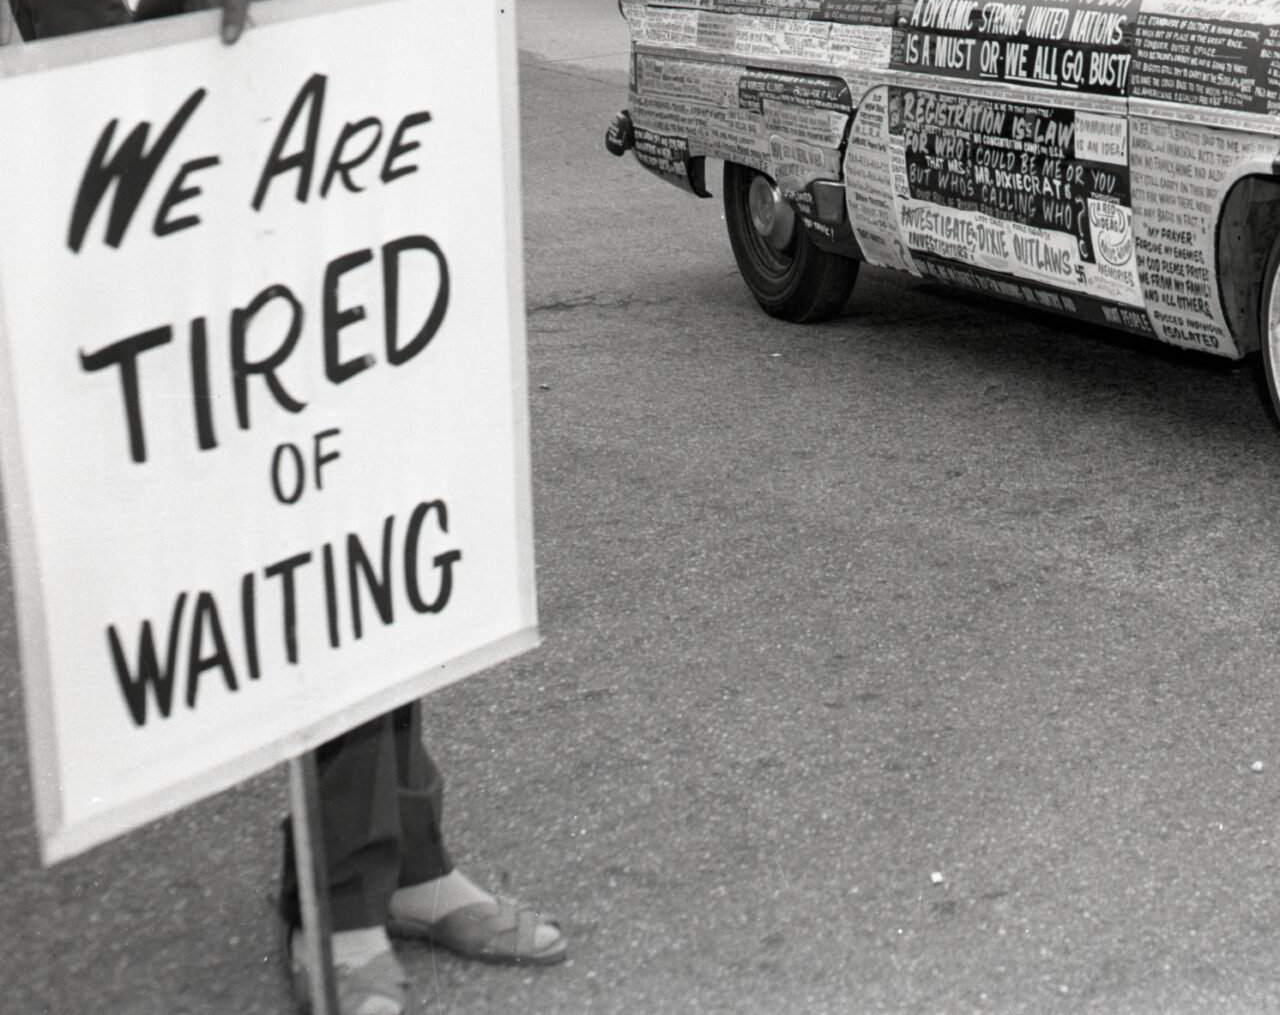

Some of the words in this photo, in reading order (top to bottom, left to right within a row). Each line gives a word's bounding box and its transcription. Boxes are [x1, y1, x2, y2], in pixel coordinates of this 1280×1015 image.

[979, 3, 1026, 36] STRONG
[1026, 6, 1069, 40] UNITED
[1068, 9, 1127, 45] NATIONS
[906, 34, 919, 64] IS
[922, 35, 930, 65] A
[935, 36, 976, 70] MUST
[1004, 42, 1029, 77] WE
[1033, 46, 1057, 81] ALL
[904, 92, 1006, 134] REGISTRATION
[67, 87, 220, 254] WE
[251, 73, 432, 212] ARE
[1013, 234, 1072, 276] OUTLAWS
[79, 235, 450, 463] TIRED
[271, 428, 341, 504] OF
[107, 500, 462, 727] WAITING
